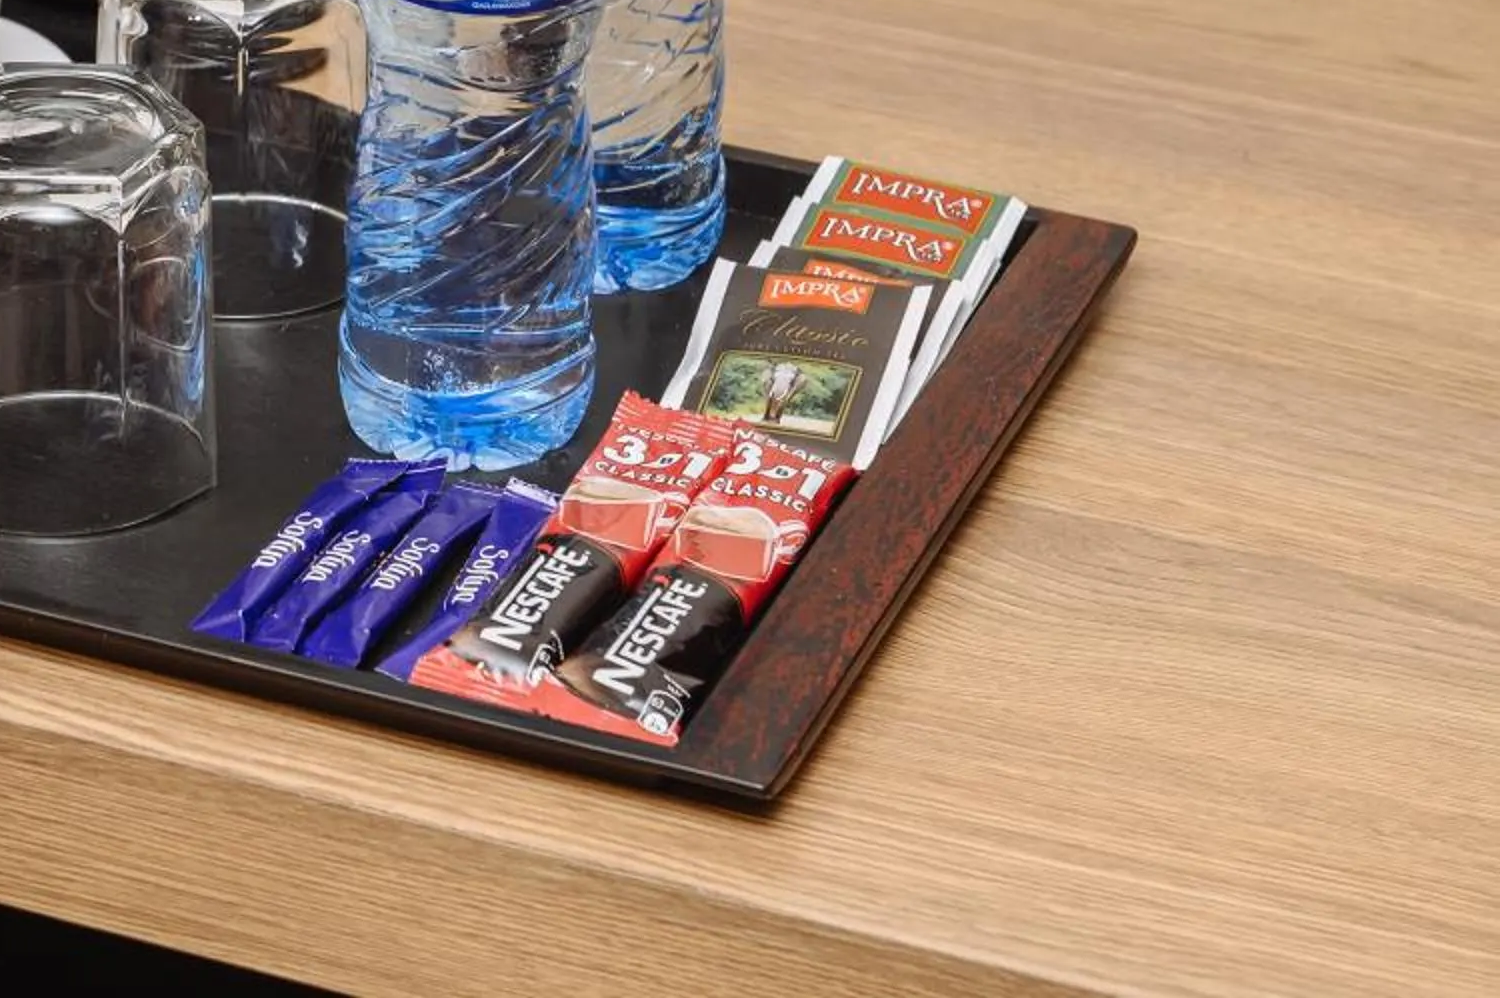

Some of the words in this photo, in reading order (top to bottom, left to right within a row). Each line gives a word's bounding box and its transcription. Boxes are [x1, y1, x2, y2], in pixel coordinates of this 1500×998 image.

[851, 171, 973, 220] IMPRA
[820, 216, 944, 263] IMPRA
[770, 278, 861, 308] IMPRA
[594, 461, 691, 488] CLASSIC
[710, 477, 806, 513] CLASSIC
